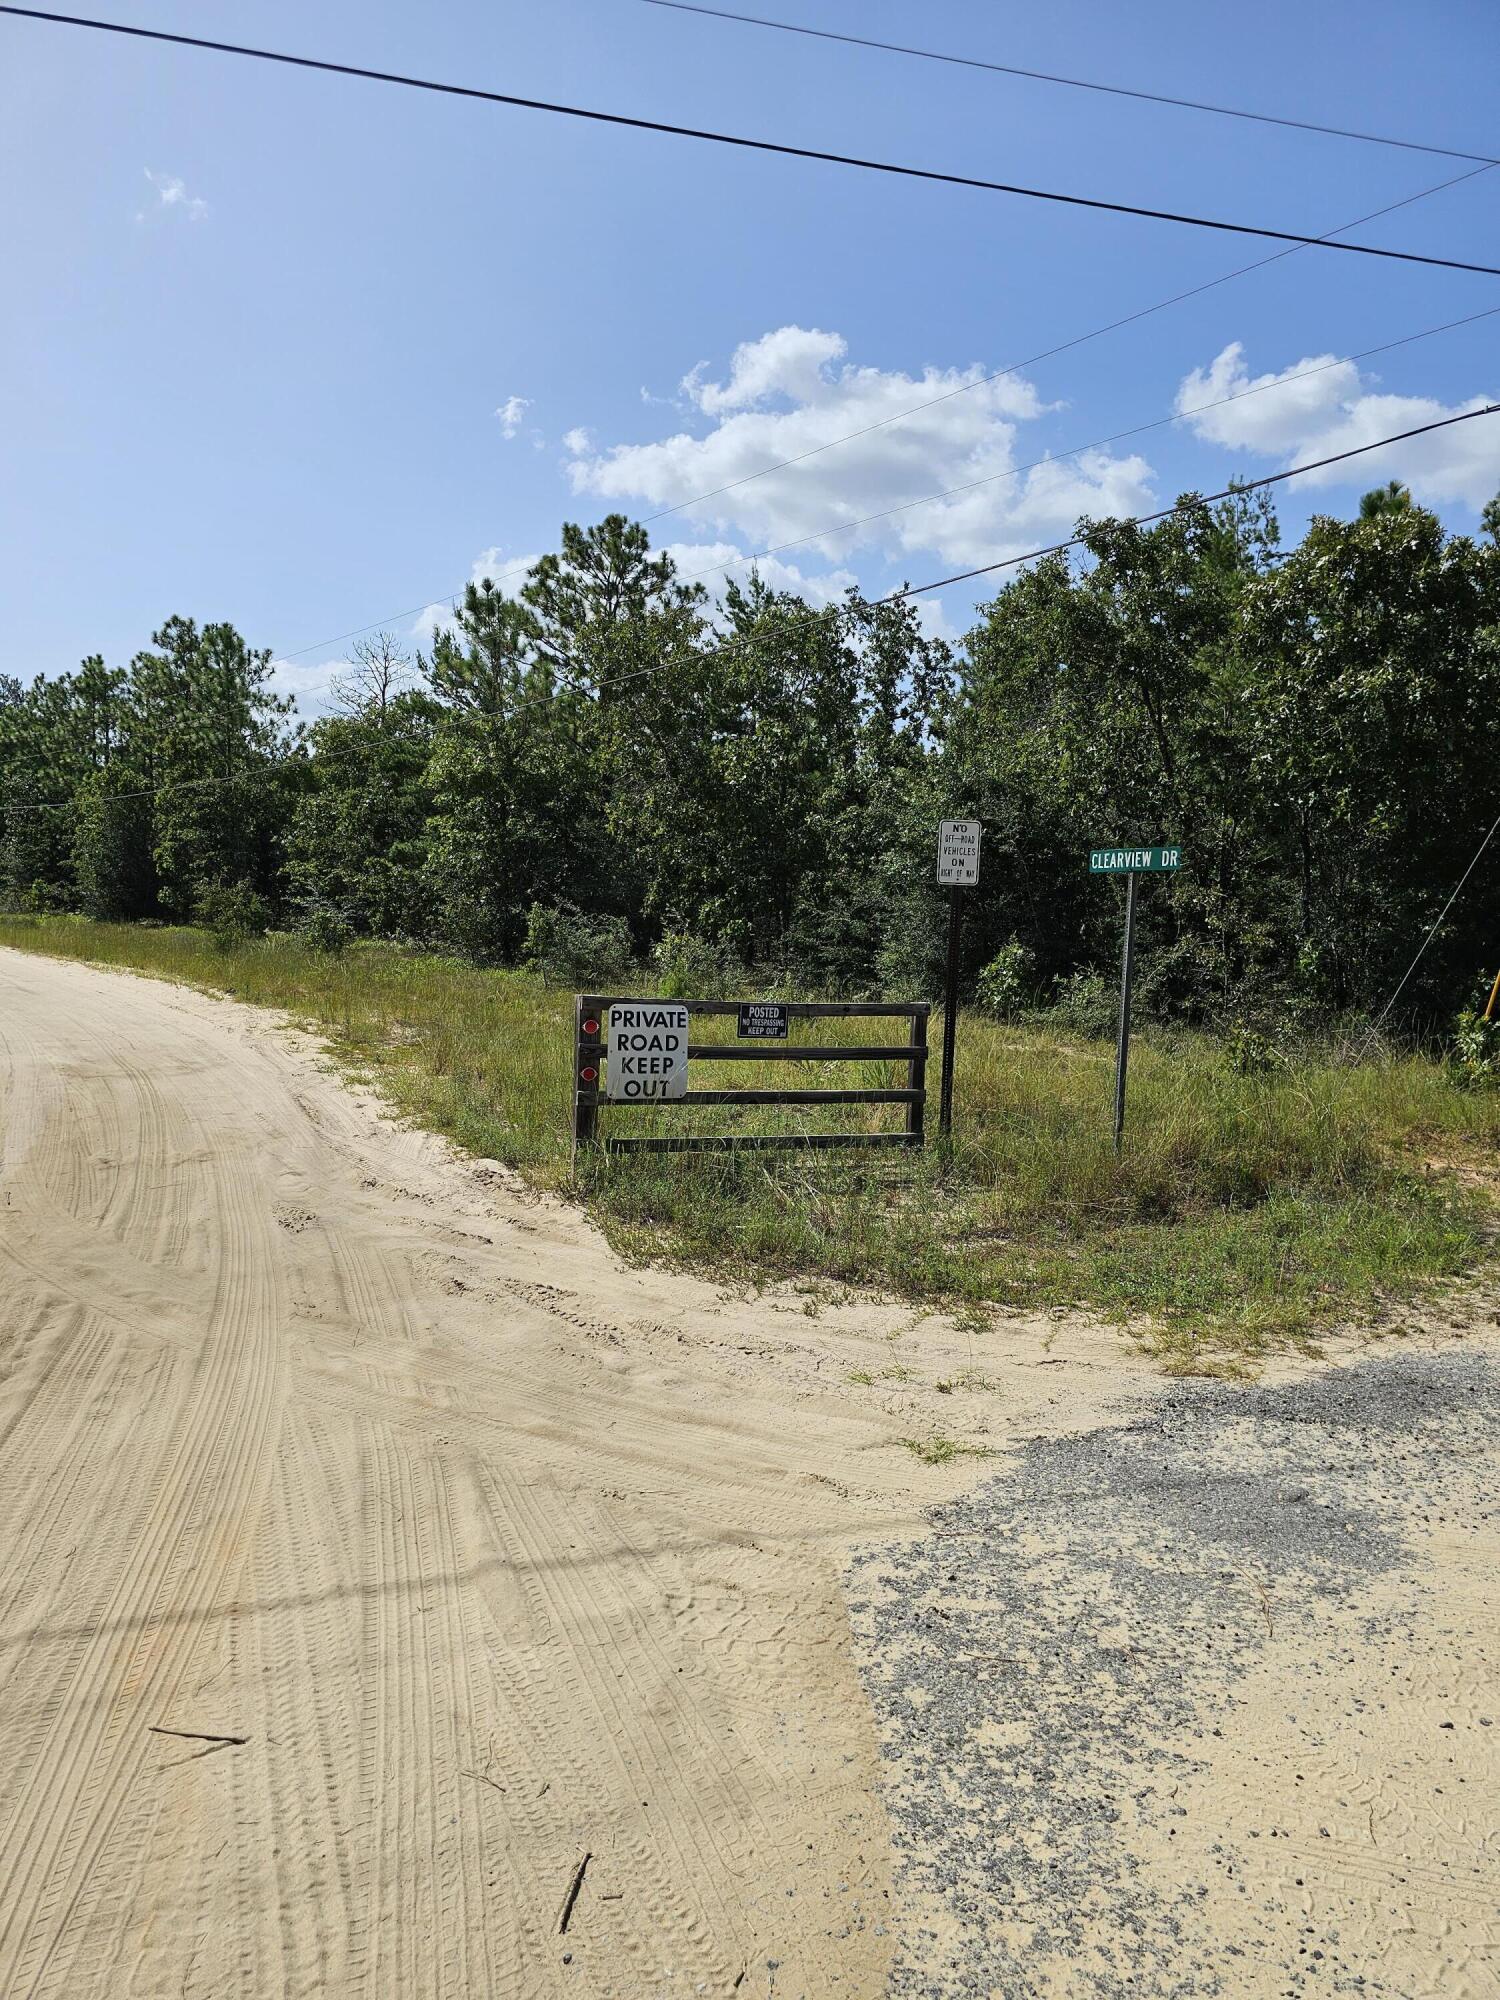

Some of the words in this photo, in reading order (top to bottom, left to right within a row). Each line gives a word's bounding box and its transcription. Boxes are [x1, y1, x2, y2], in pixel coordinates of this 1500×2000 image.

[952, 824, 968, 833] NO
[943, 846, 976, 856] VEHICLES
[951, 858, 965, 867] ON
[1091, 851, 1152, 869] CLEARVIEW
[1161, 850, 1178, 867] DR
[748, 1006, 780, 1019] POSTED
[611, 1010, 687, 1029] PRIVATE
[742, 1017, 751, 1026] NO
[751, 1018, 785, 1027] TRESPASSING
[747, 1026, 765, 1035] KEEP
[765, 1027, 778, 1035] OUT
[617, 1034, 679, 1052] ROAD
[621, 1057, 674, 1074] KEEP
[624, 1080, 670, 1097] OUT
